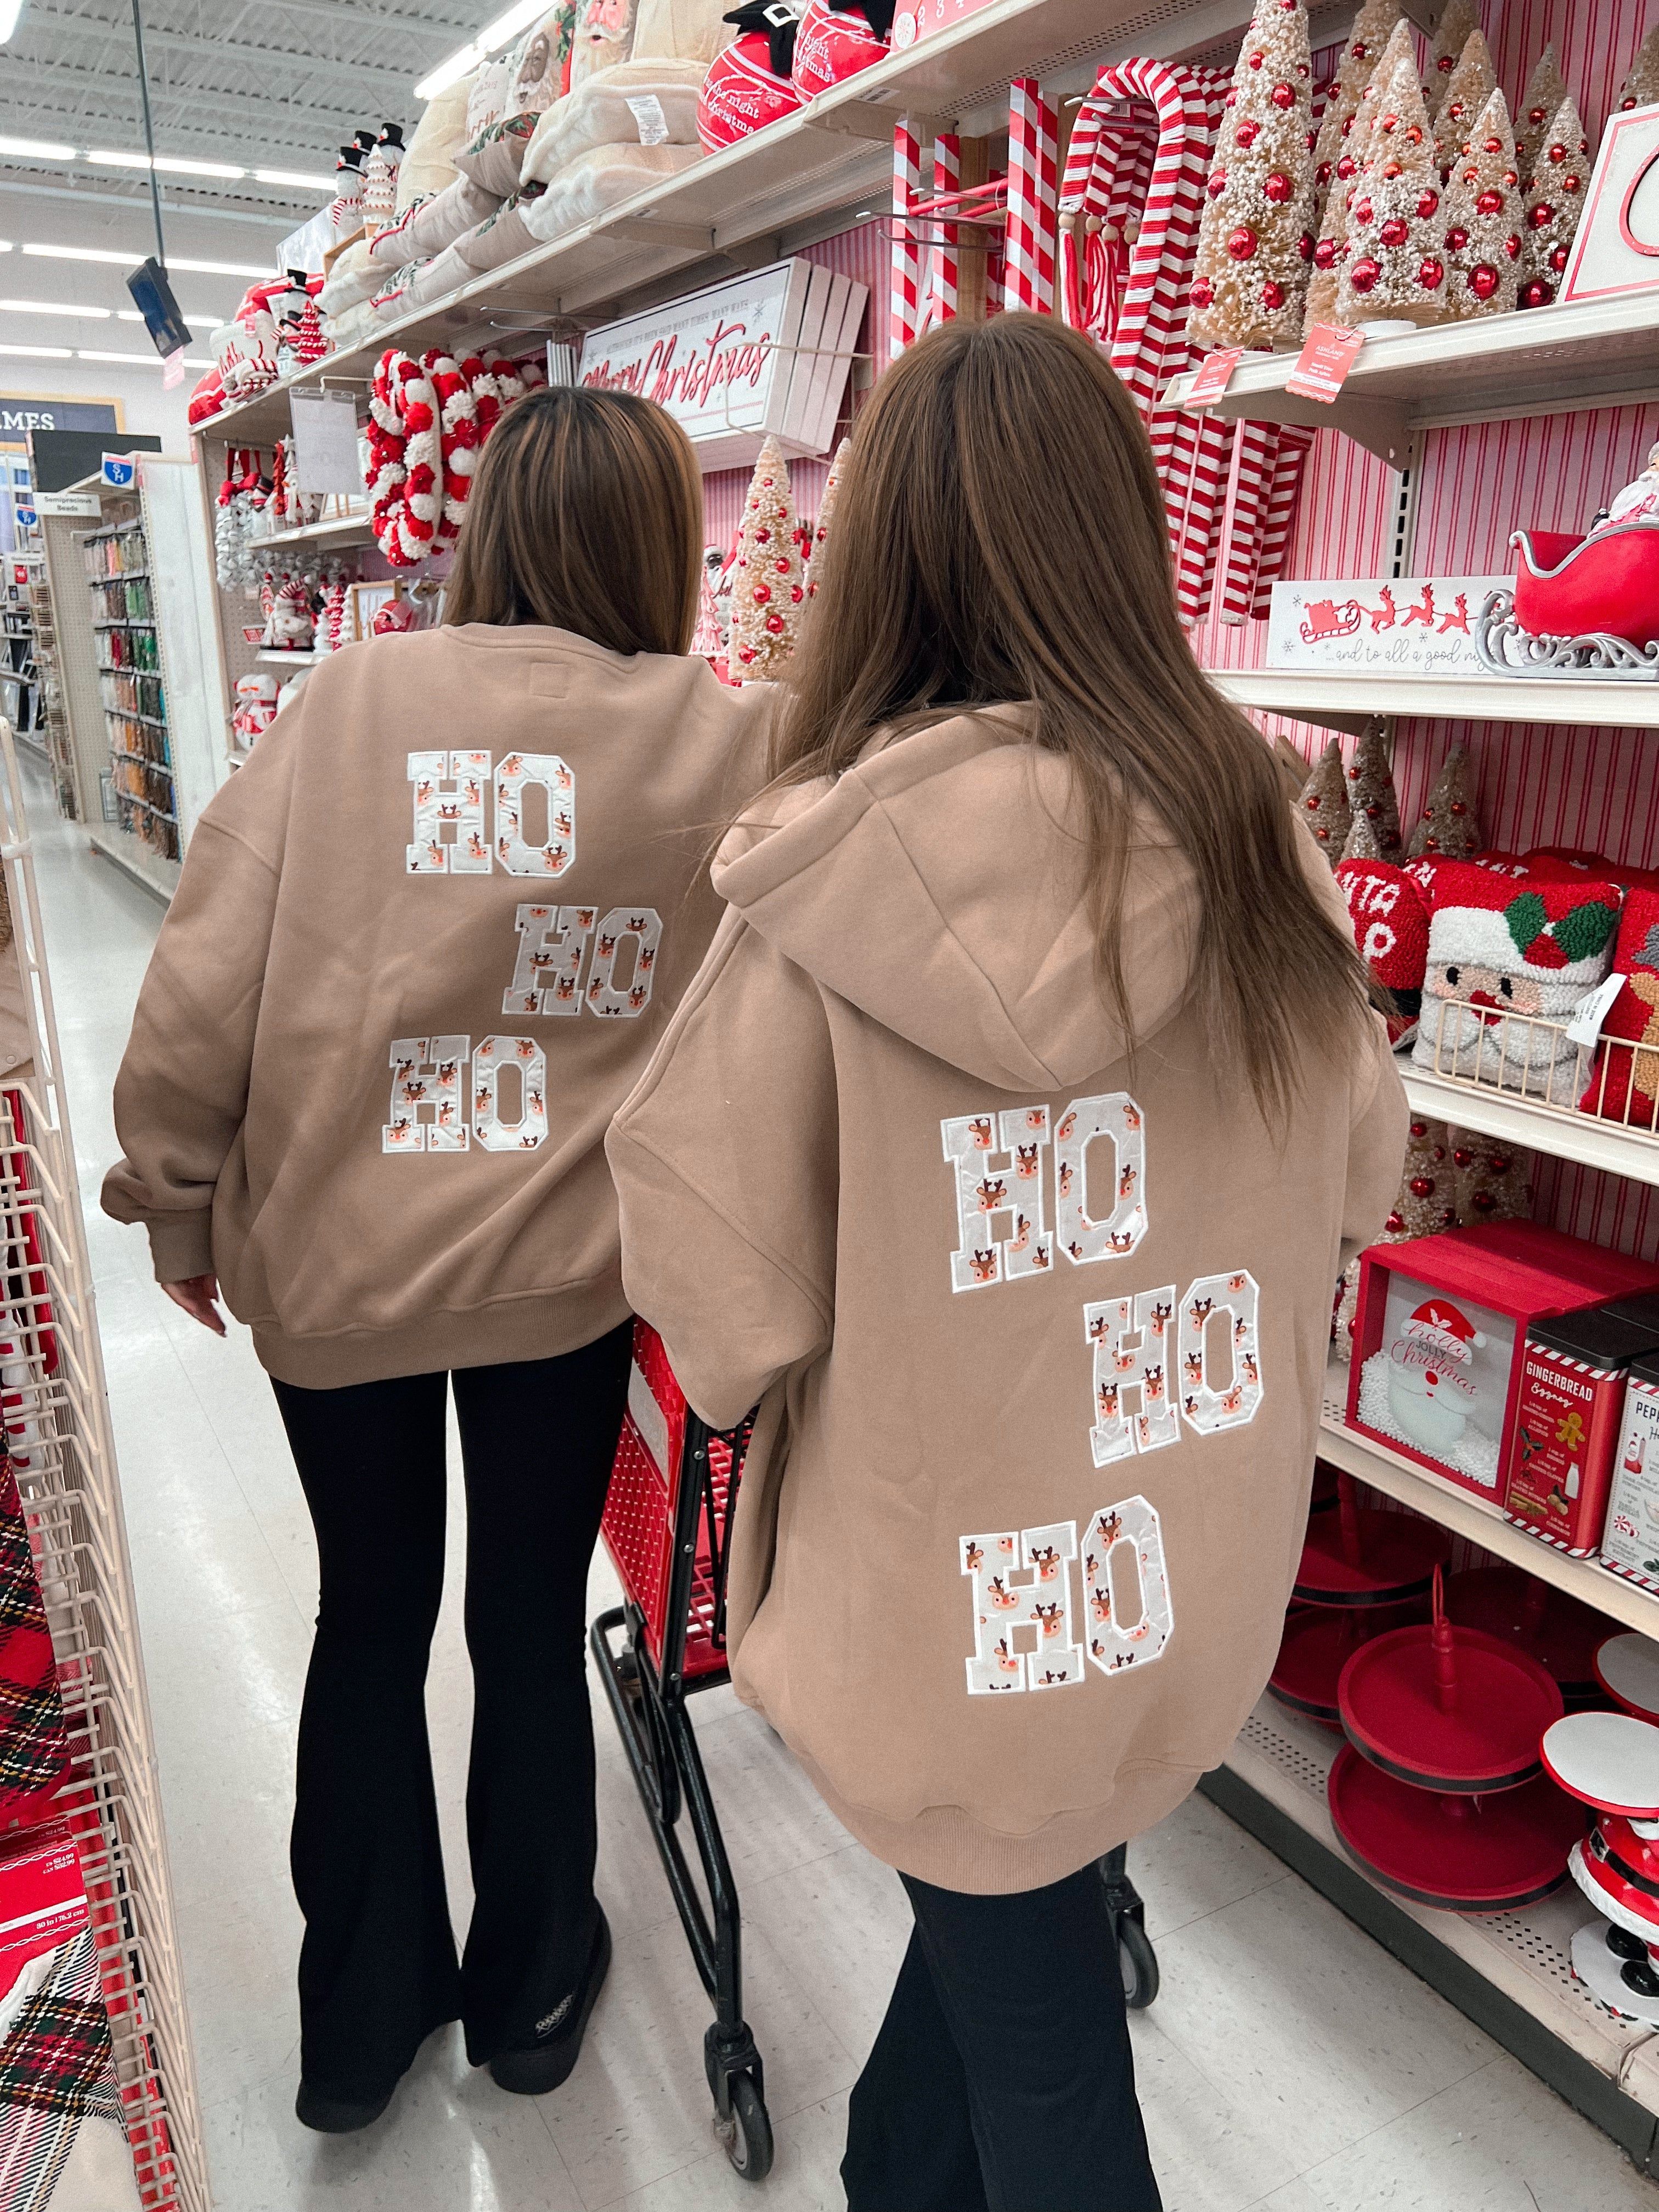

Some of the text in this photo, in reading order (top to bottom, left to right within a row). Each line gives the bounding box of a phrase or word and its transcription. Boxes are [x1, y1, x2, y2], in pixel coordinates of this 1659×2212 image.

[917, 5, 926, 27] 2
[707, 102, 755, 135] christma
[726, 94, 760, 119] night
[638, 319, 770, 408] Christmas
[1315, 345, 1345, 357] ASHLAND
[0, 411, 54, 430] MES
[1365, 646, 1381, 662] to
[1385, 639, 1409, 663] all
[1412, 650, 1422, 663] a
[1424, 639, 1462, 670] good
[406, 750, 575, 878] HO
[501, 904, 663, 1018] HO
[382, 1035, 549, 1153] HO
[940, 1091, 1149, 1293] HO
[1404, 1323, 1468, 1363] holly
[1415, 1340, 1446, 1359] JOLLY
[1084, 1269, 1264, 1468] HO
[1391, 1340, 1477, 1395] Christmas
[1526, 1361, 1593, 1402] GINGERBREAD
[959, 1494, 1175, 1695] HO
[53, 1853, 74, 1864] $24.99
